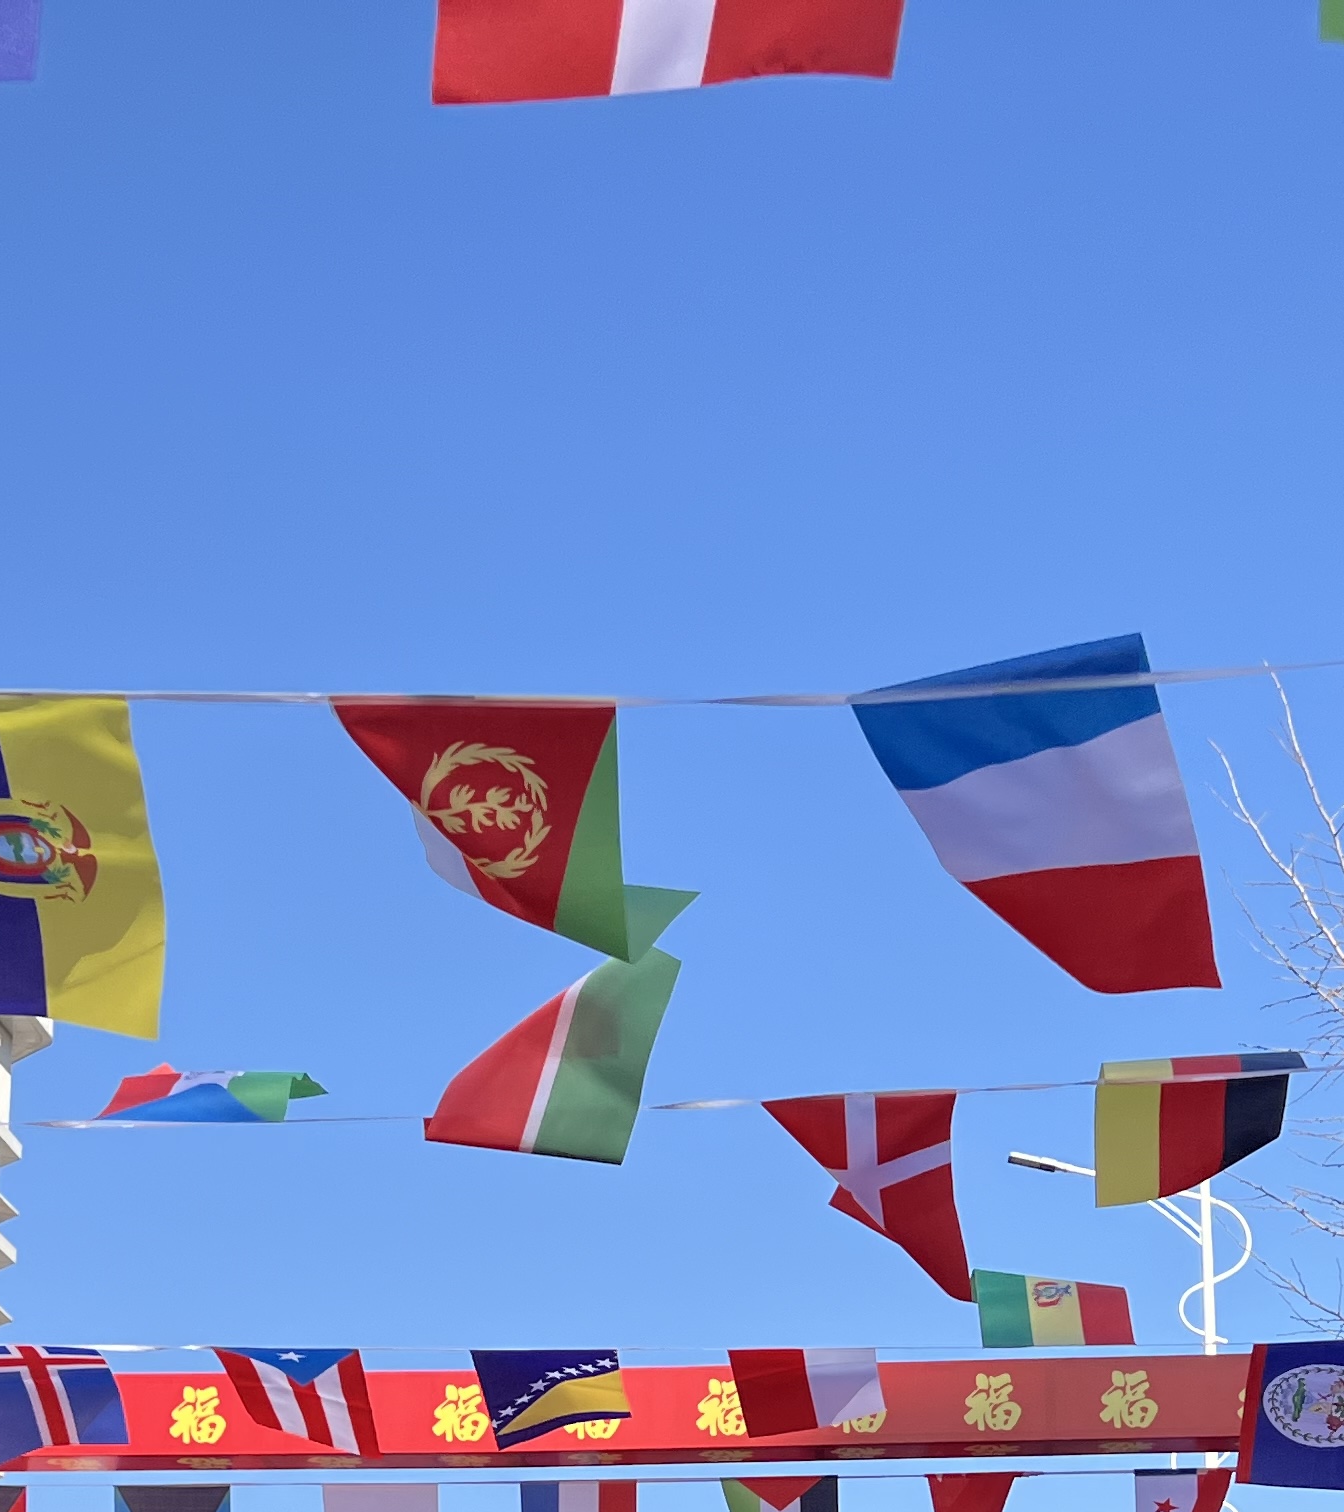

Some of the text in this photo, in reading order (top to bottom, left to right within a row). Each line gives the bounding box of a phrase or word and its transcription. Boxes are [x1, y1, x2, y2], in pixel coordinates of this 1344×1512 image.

[169, 1386, 227, 1446] 福
[433, 1384, 490, 1443] 福
[964, 1373, 1023, 1433] 福
[1100, 1370, 1159, 1430] 福
